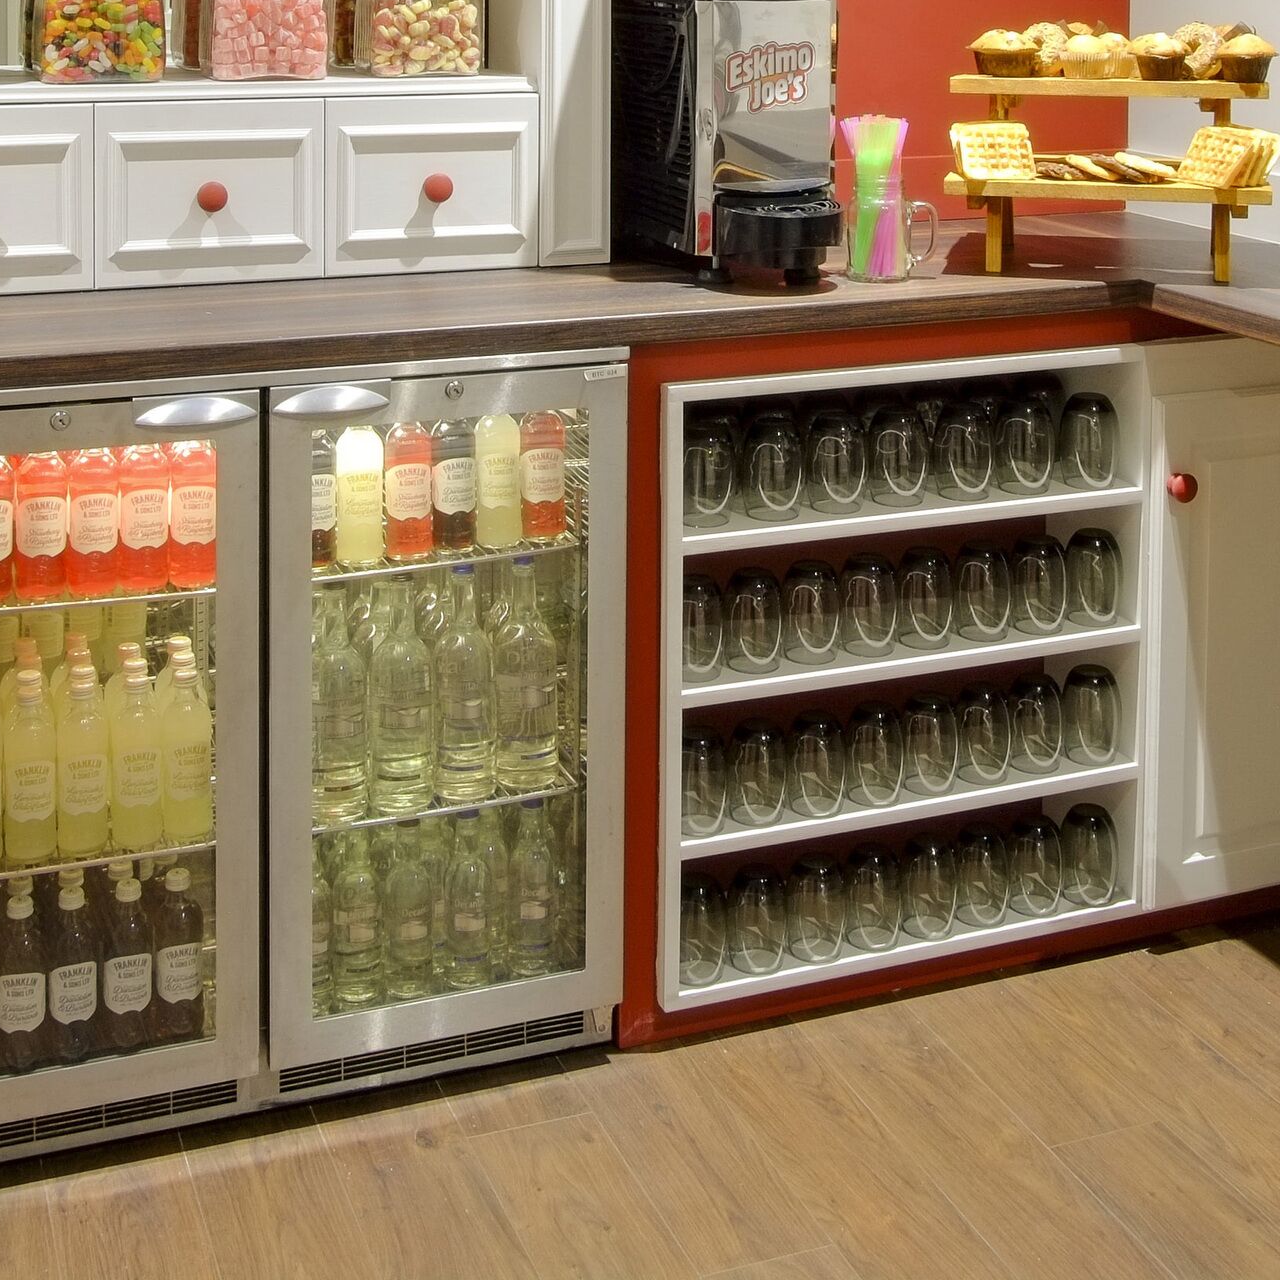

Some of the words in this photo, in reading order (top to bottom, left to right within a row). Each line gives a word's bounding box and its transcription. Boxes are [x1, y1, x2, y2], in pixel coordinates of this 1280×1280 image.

[728, 44, 814, 89] Eskimo
[131, 494, 164, 506] FRANKLIN
[180, 490, 213, 502] FRANKLIN
[26, 501, 61, 513] FRANKLIN
[79, 499, 113, 510] FRANKLIN
[165, 948, 198, 960] FRANKLIN
[113, 958, 147, 971] FRANKLIN
[59, 966, 92, 981] FRANKLIN
[3, 978, 38, 989] FRANKLIN
